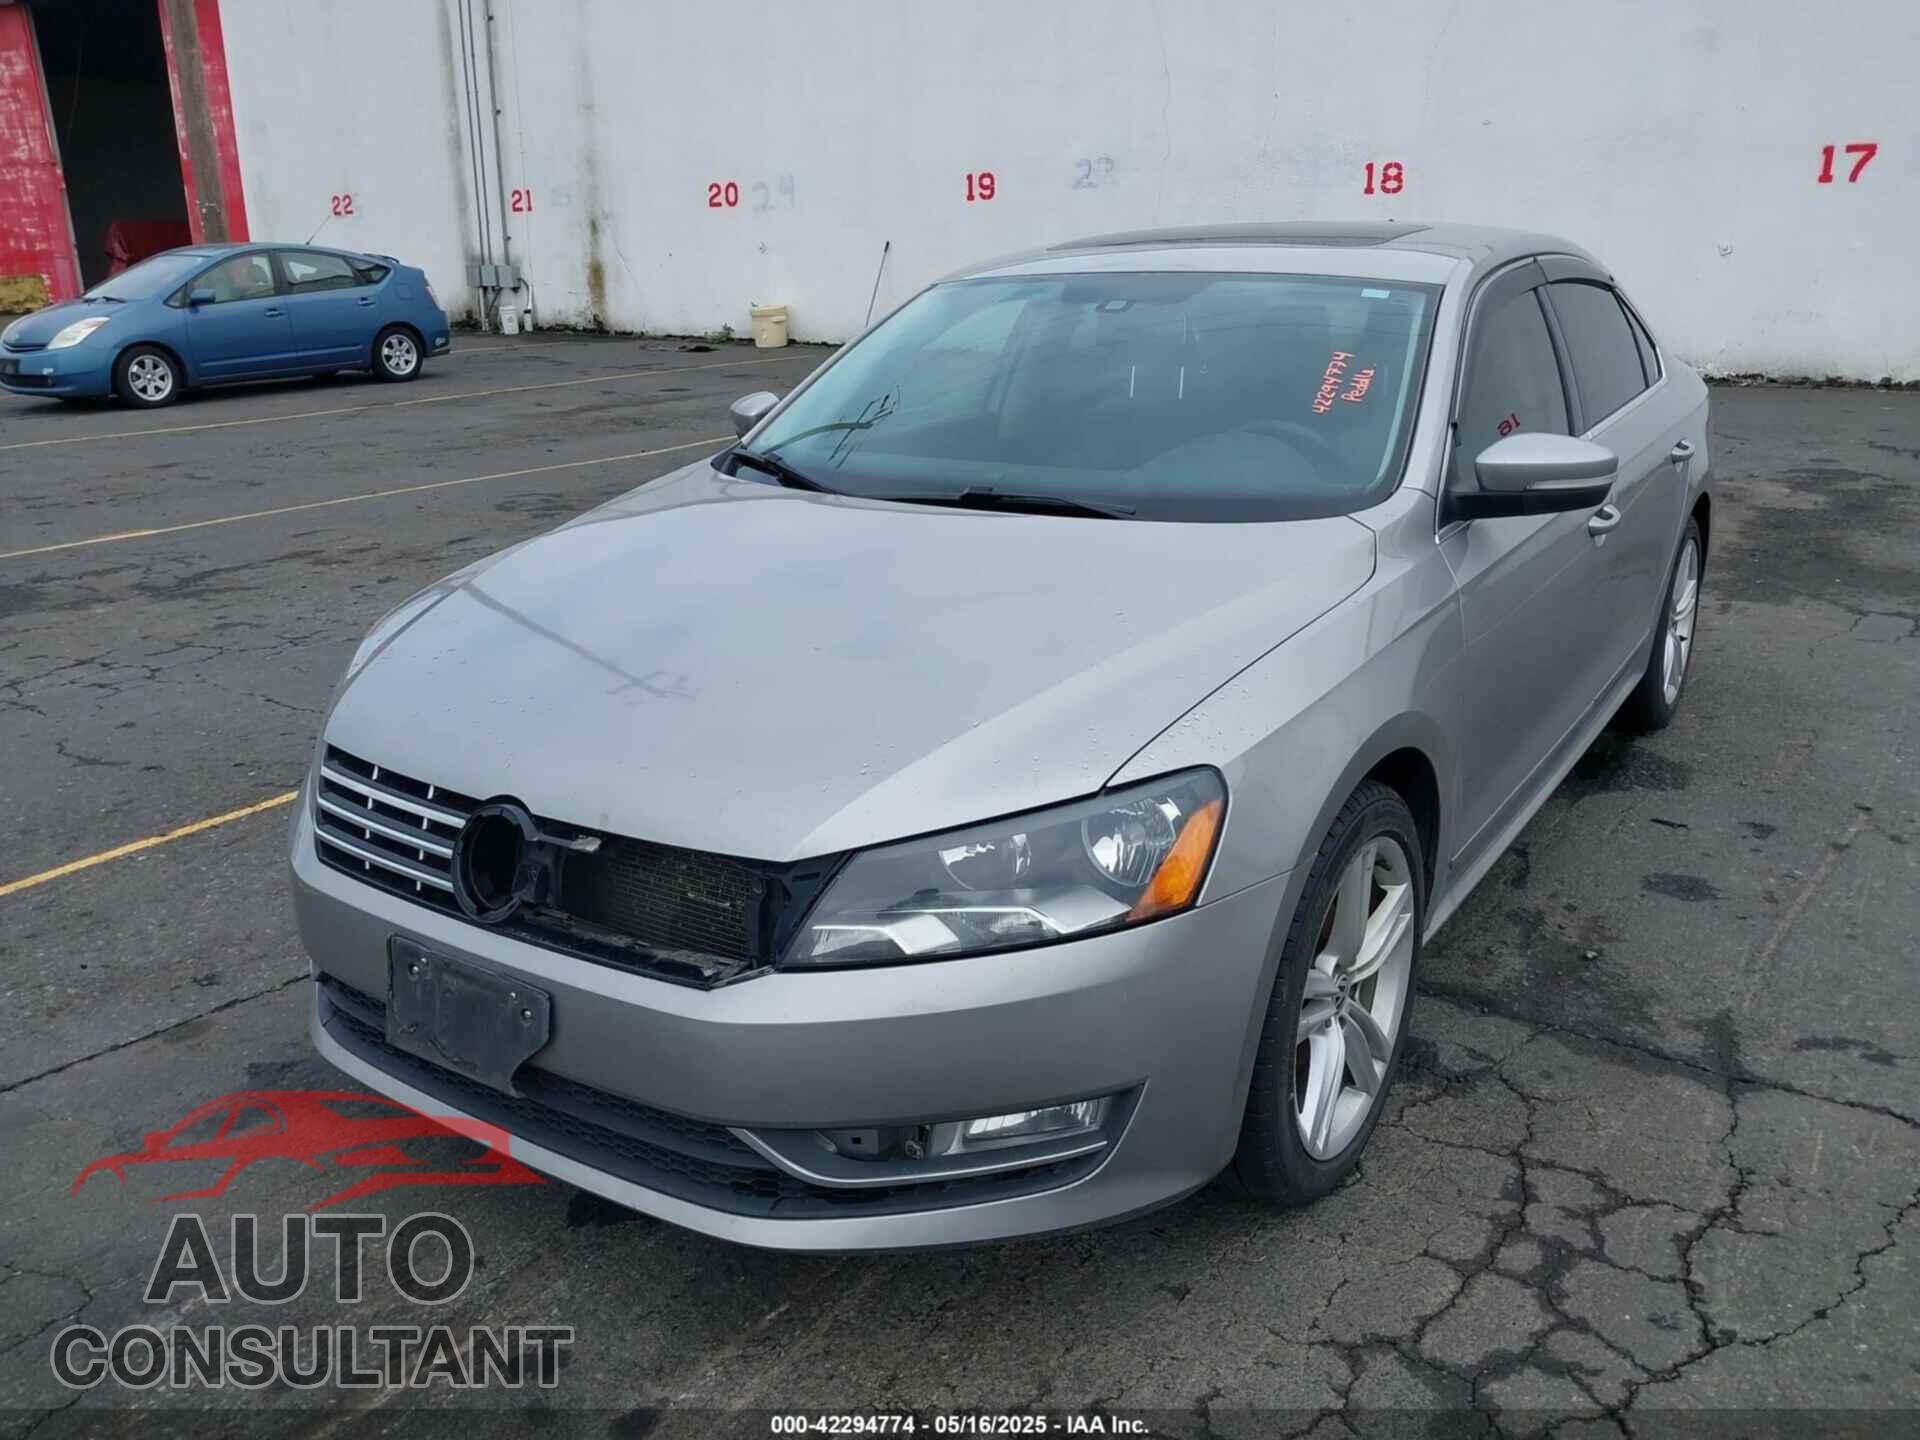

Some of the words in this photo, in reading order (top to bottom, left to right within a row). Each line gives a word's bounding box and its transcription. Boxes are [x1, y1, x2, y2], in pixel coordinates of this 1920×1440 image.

[1363, 160, 1405, 196] 18
[1817, 143, 1879, 184] 17
[510, 190, 533, 213] 21
[707, 181, 739, 208] 20
[965, 171, 996, 203] 19
[331, 194, 354, 217] 22
